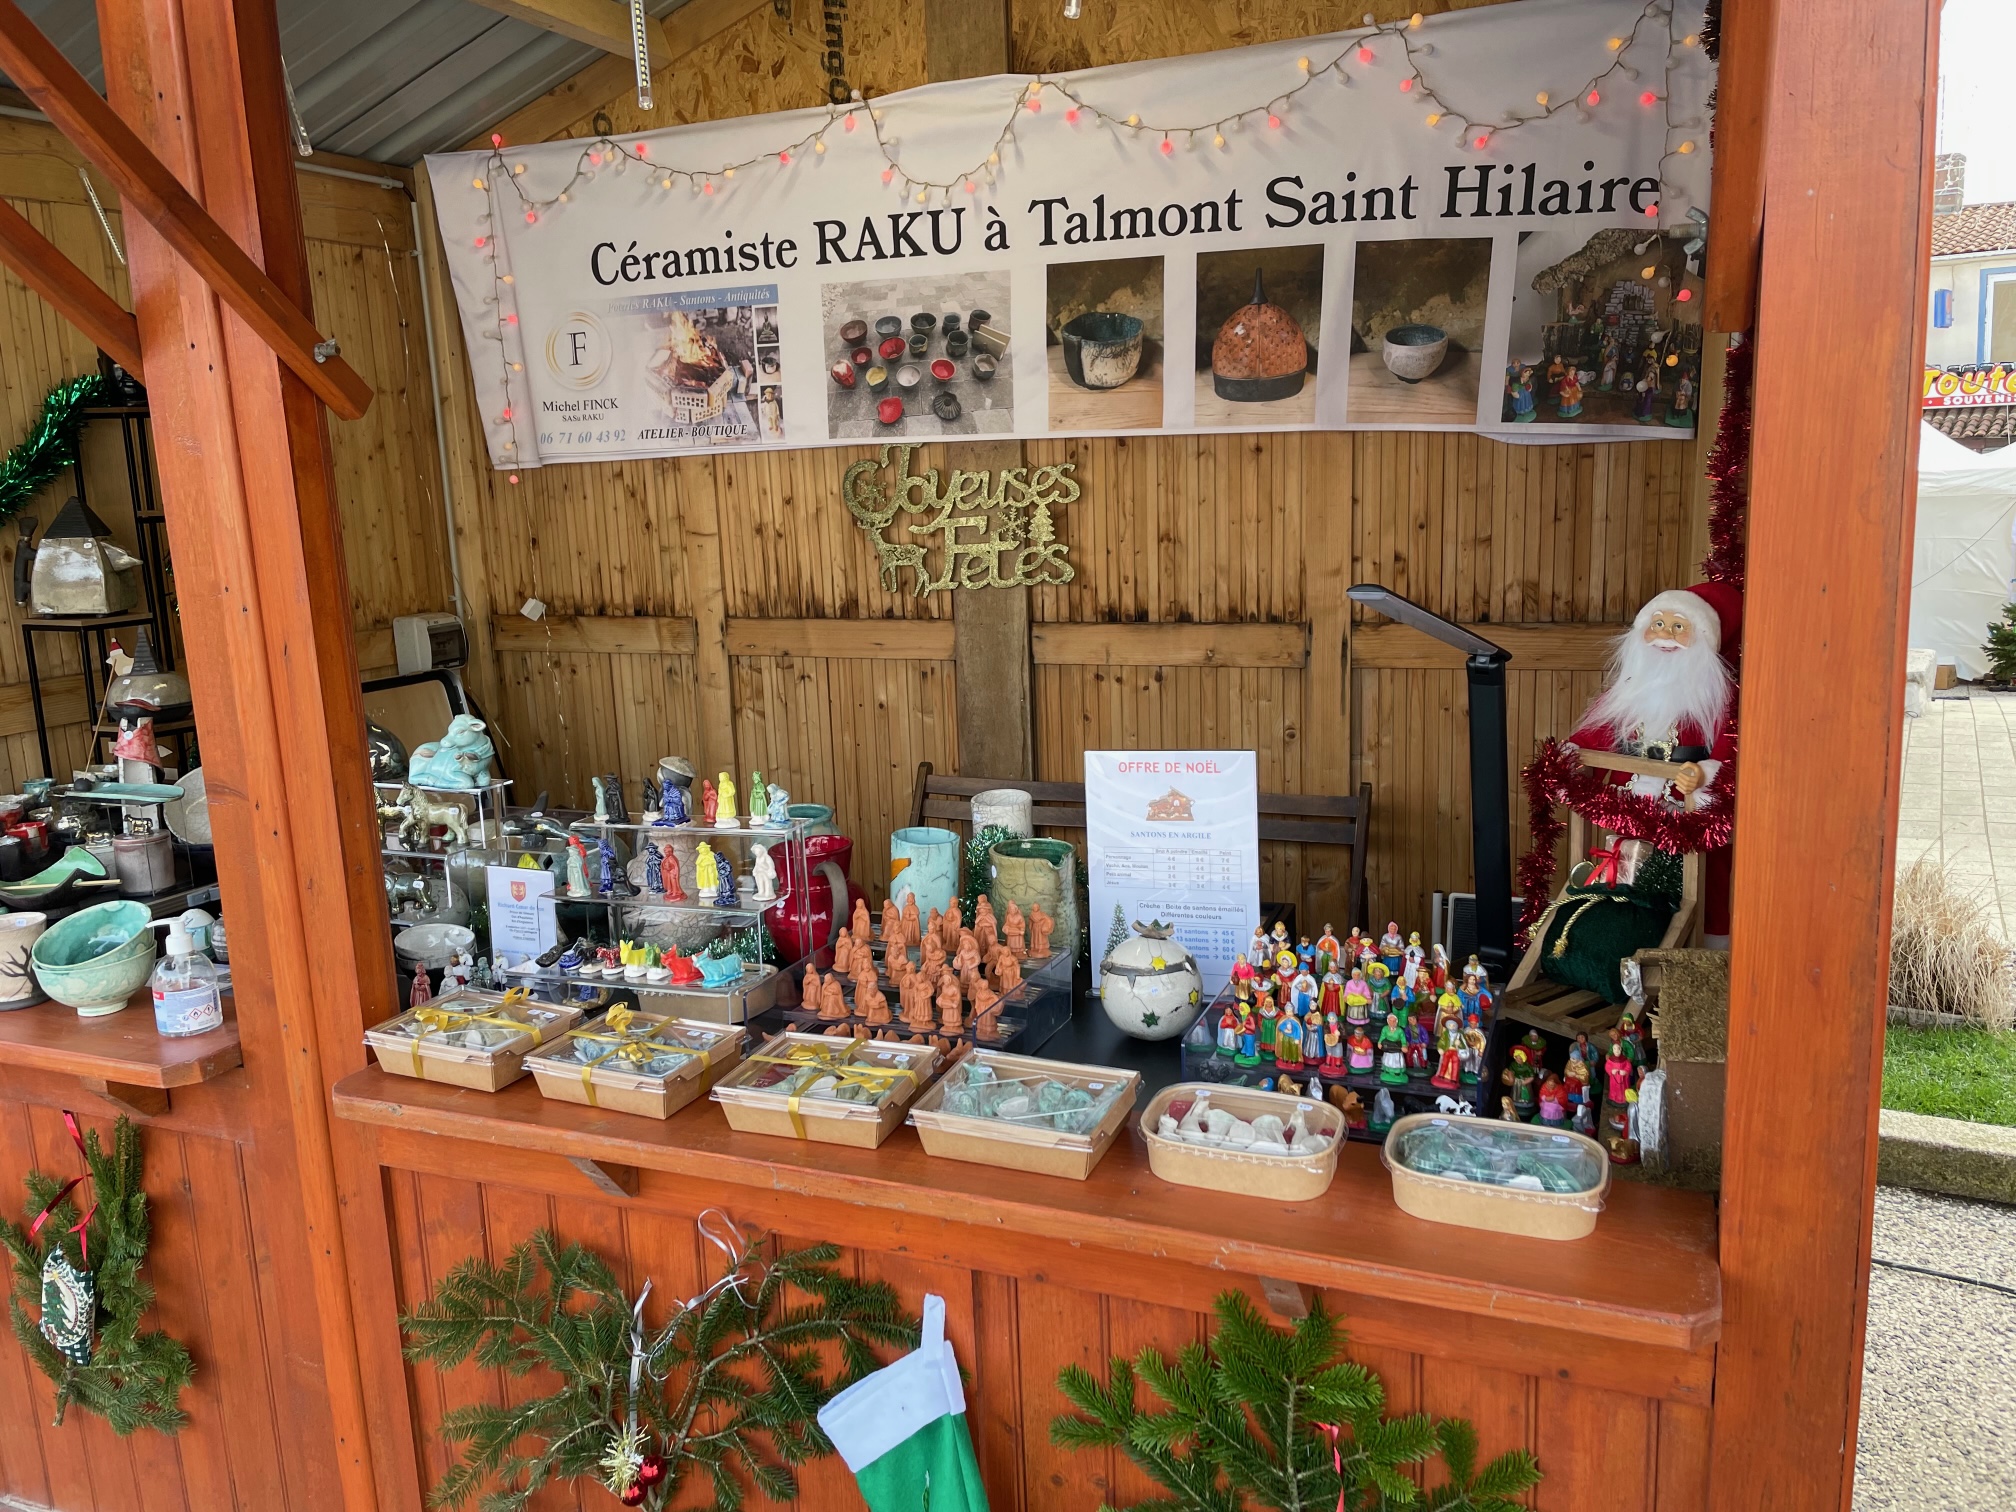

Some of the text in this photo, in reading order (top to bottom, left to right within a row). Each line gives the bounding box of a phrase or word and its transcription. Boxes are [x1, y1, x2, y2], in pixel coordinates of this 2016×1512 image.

[590, 160, 1662, 286] Céramiste RAKU à Talmont Saint Hilaire
[642, 296, 673, 309] RAKU
[680, 293, 717, 307] Santons
[723, 287, 771, 304] Antiquités
[566, 331, 587, 366] F
[542, 398, 620, 412] Michel FINCK
[1943, 394, 2016, 406] SOUVENI
[582, 413, 605, 422] RAKU
[540, 429, 626, 444] 06 71 60 43 92
[637, 425, 684, 440] ATELIER
[691, 424, 748, 439] BOUTIQUE
[1118, 760, 1221, 774] OFFRE DE NOËL
[1130, 831, 1167, 839] SANTONS
[1181, 832, 1212, 840] ARGILE
[1160, 911, 1194, 919] Différentes
[1218, 905, 1244, 913] émaillés
